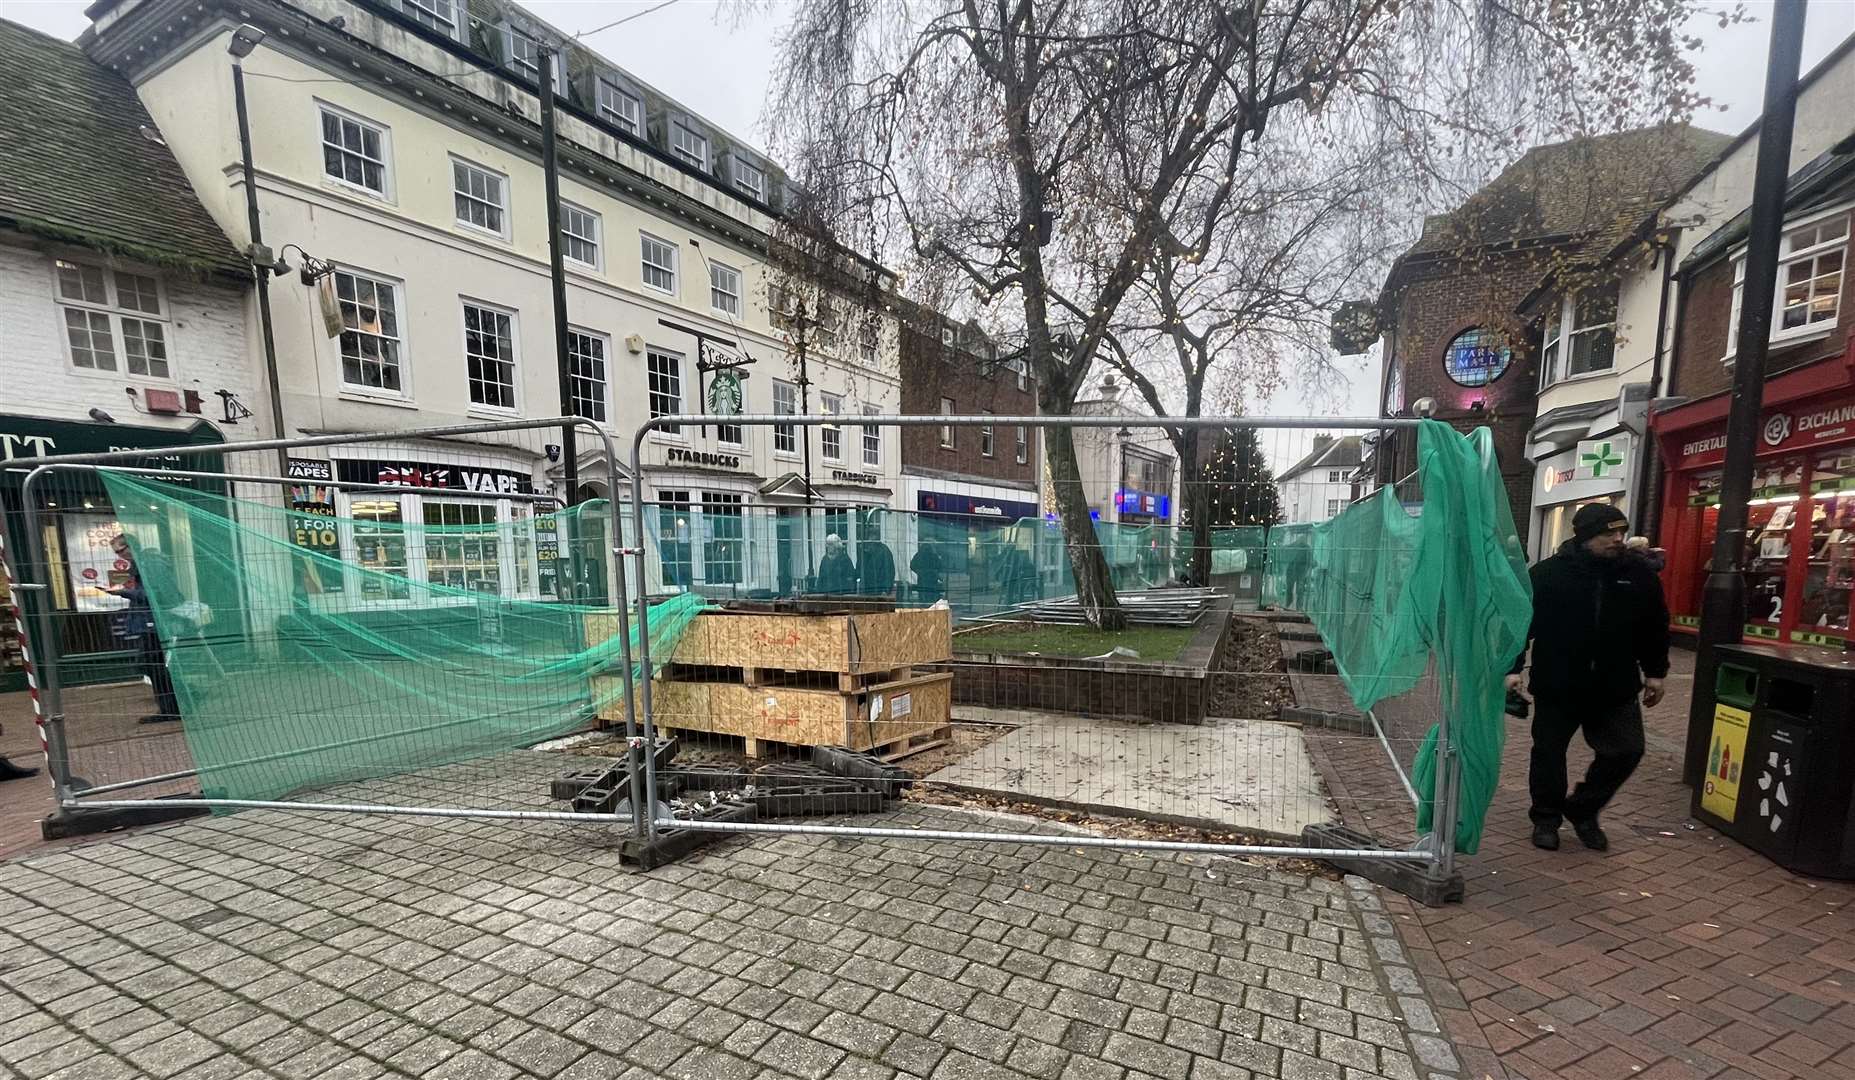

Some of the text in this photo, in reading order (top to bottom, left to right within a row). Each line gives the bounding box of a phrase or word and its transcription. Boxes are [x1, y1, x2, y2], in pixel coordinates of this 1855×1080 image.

[1460, 348, 1495, 359] PARK
[1458, 356, 1496, 368] MALL
[1683, 434, 1728, 456] ENTERTAI
[667, 448, 740, 468] STARBUCKS
[461, 471, 519, 494] VAPE
[832, 470, 877, 485] STARBUCKS
[304, 519, 335, 530] FOR
[538, 551, 559, 561] £20
